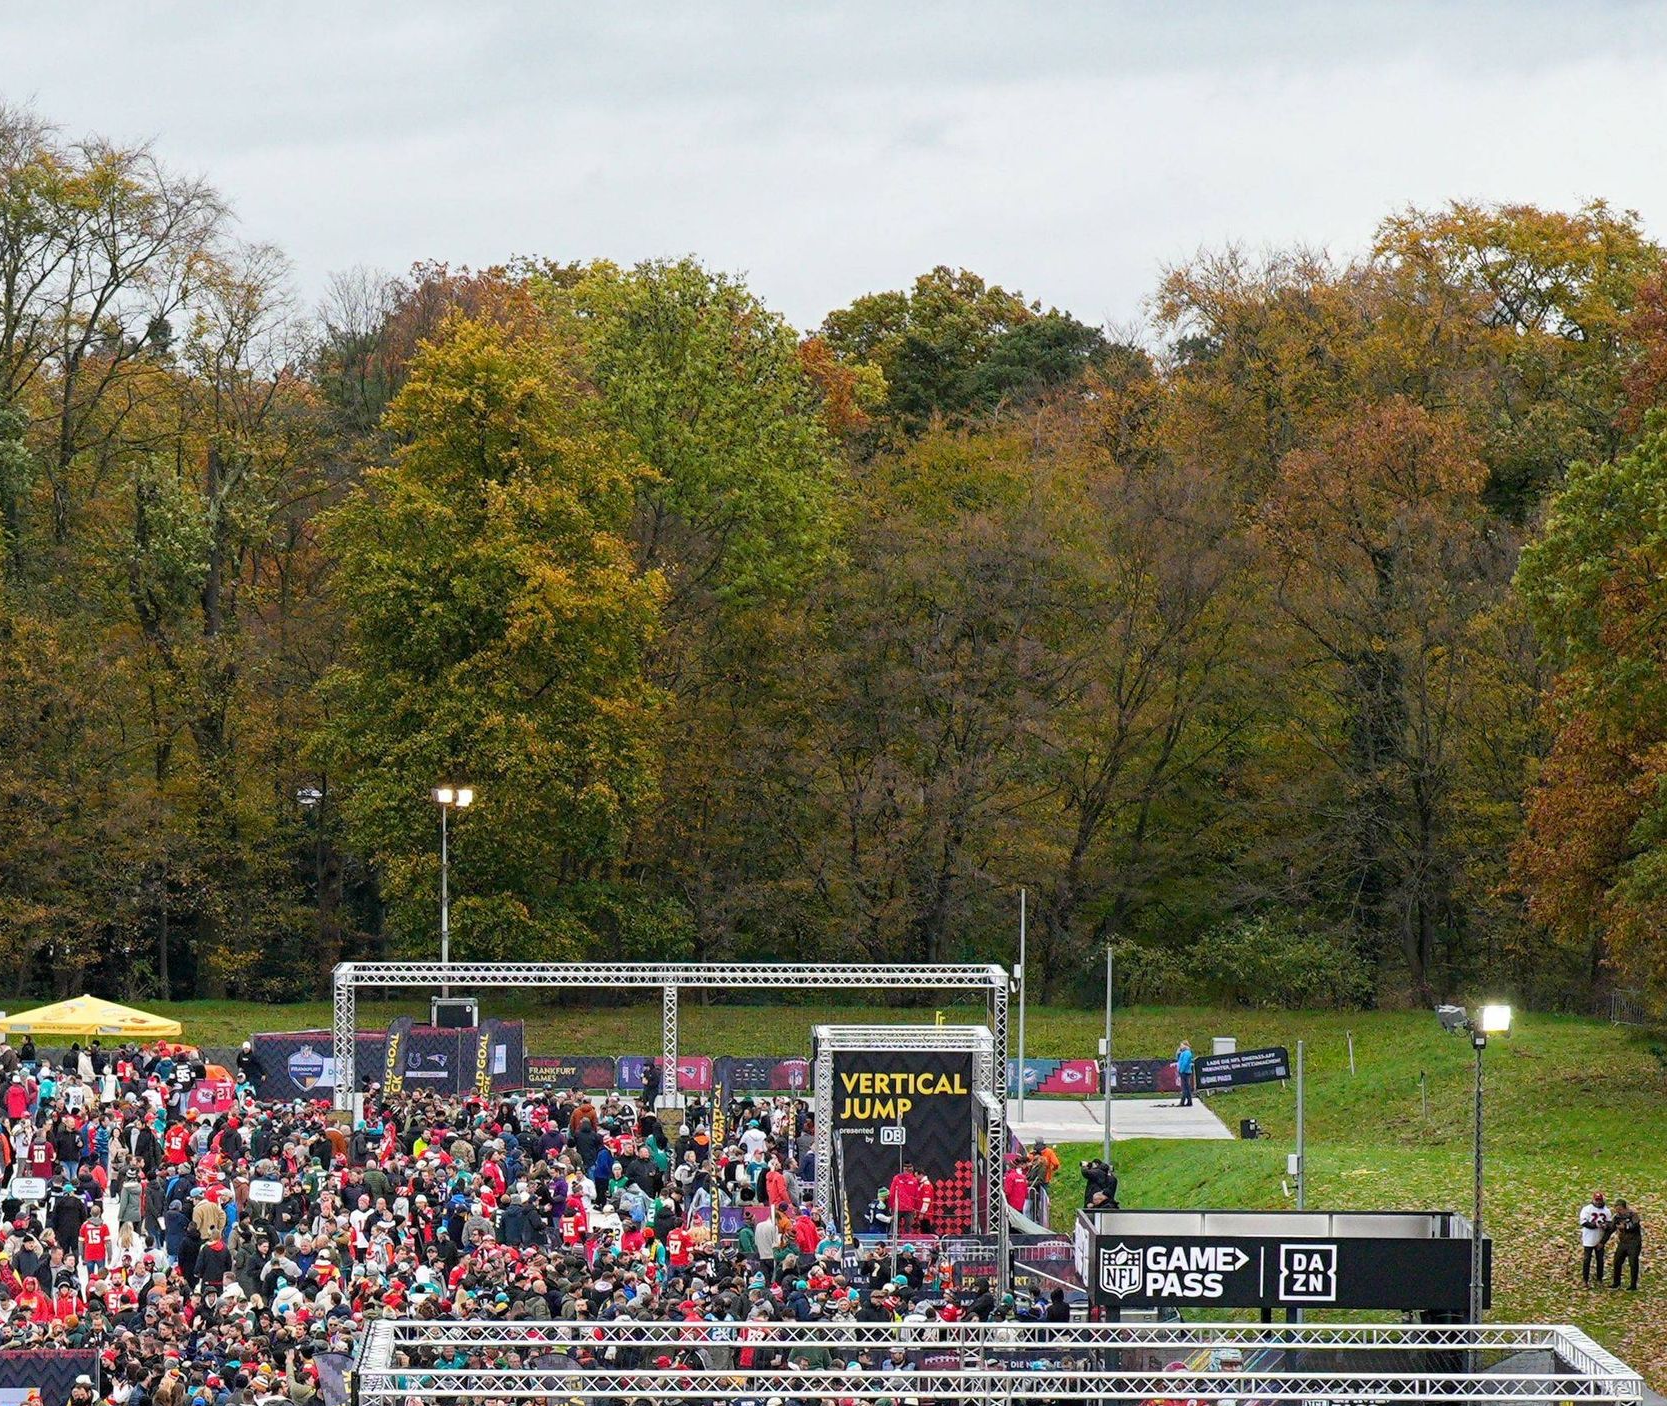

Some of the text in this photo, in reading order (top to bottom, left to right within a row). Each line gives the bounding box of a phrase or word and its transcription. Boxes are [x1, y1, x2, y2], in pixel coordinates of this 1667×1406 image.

[529, 1067, 576, 1075] FRANKFURT
[529, 1074, 557, 1082] GAMES
[840, 1072, 967, 1095] VERTICAL
[840, 1098, 912, 1120] JUMP
[839, 1127, 874, 1135] presented
[866, 1136, 874, 1144] by
[33, 1151, 45, 1164] 10
[87, 1230, 101, 1244] 15
[669, 1241, 681, 1255] 87
[1293, 1253, 1324, 1271] DA
[1106, 1267, 1137, 1288] NFL
[1293, 1275, 1323, 1292] ZN
[1146, 1273, 1223, 1297] PASS
